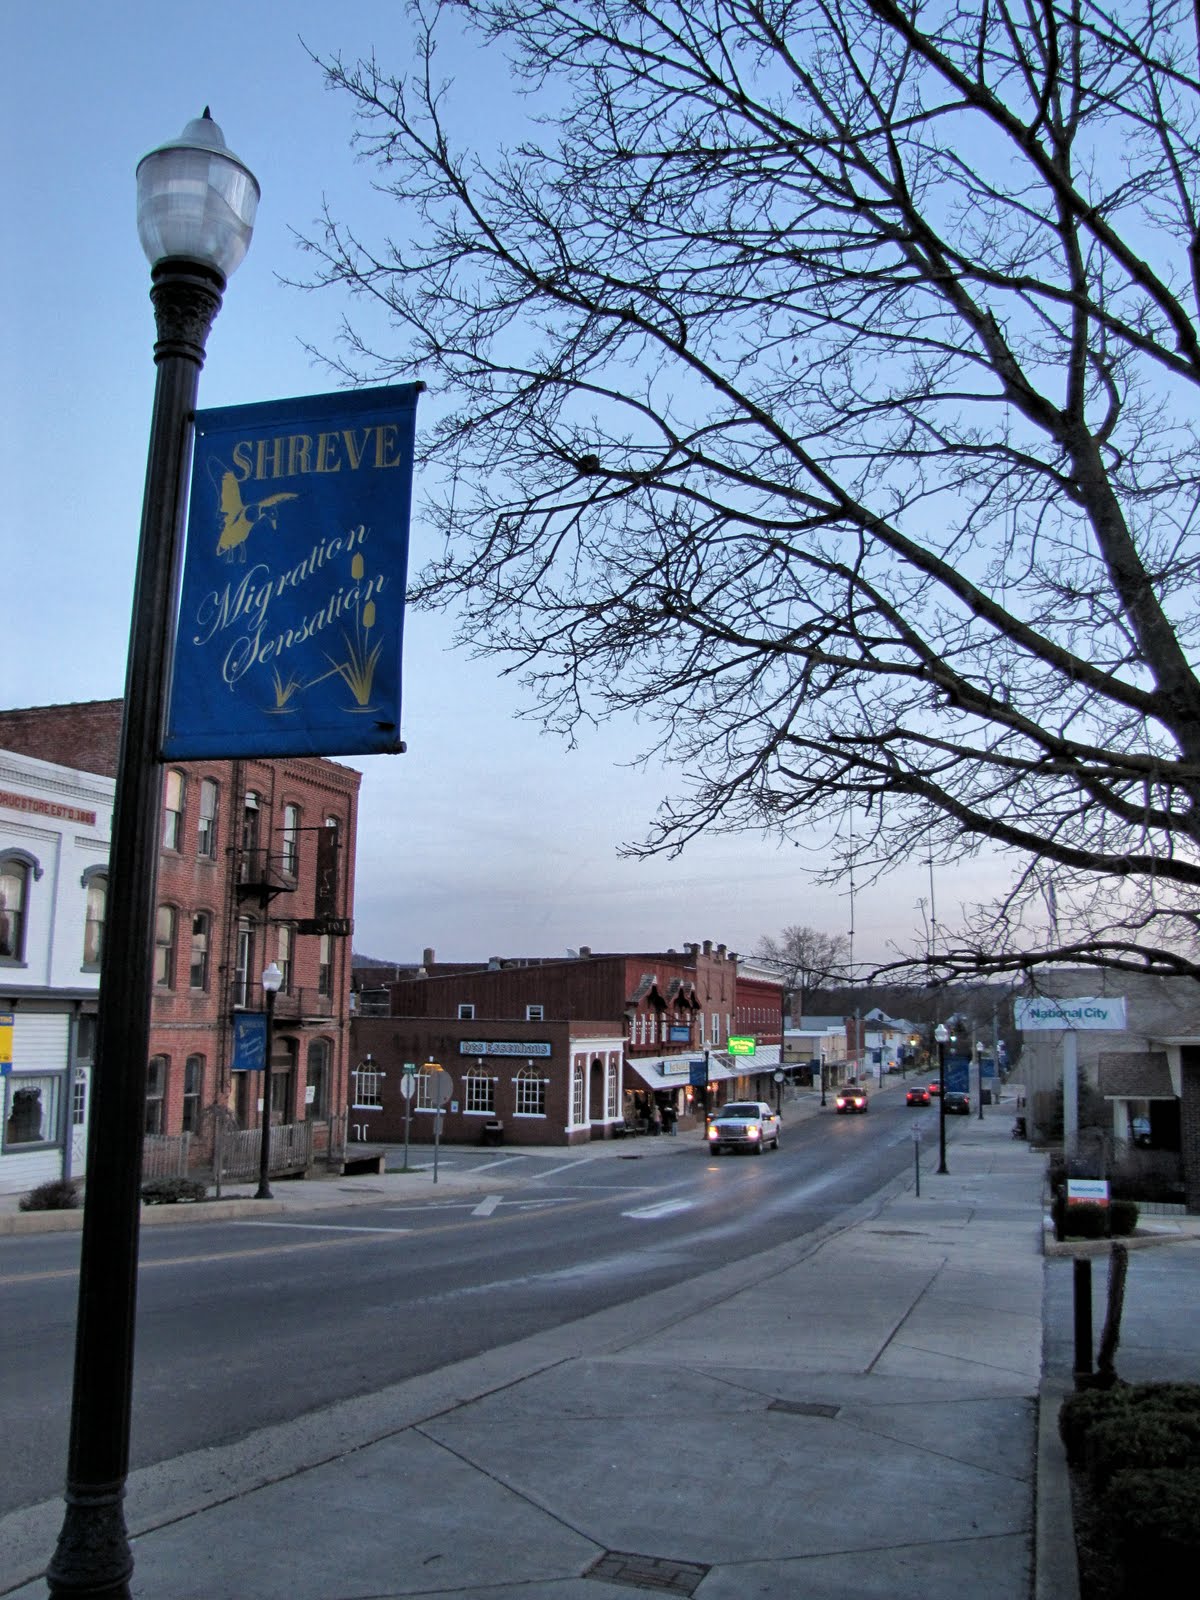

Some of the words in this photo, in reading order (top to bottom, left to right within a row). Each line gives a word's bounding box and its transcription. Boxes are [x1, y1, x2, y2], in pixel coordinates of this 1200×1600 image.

[231, 424, 402, 482] SHREVE
[193, 522, 371, 646] Migration
[222, 574, 391, 692] Sensation
[1031, 1007, 1082, 1019] National
[1084, 1007, 1108, 1021] City
